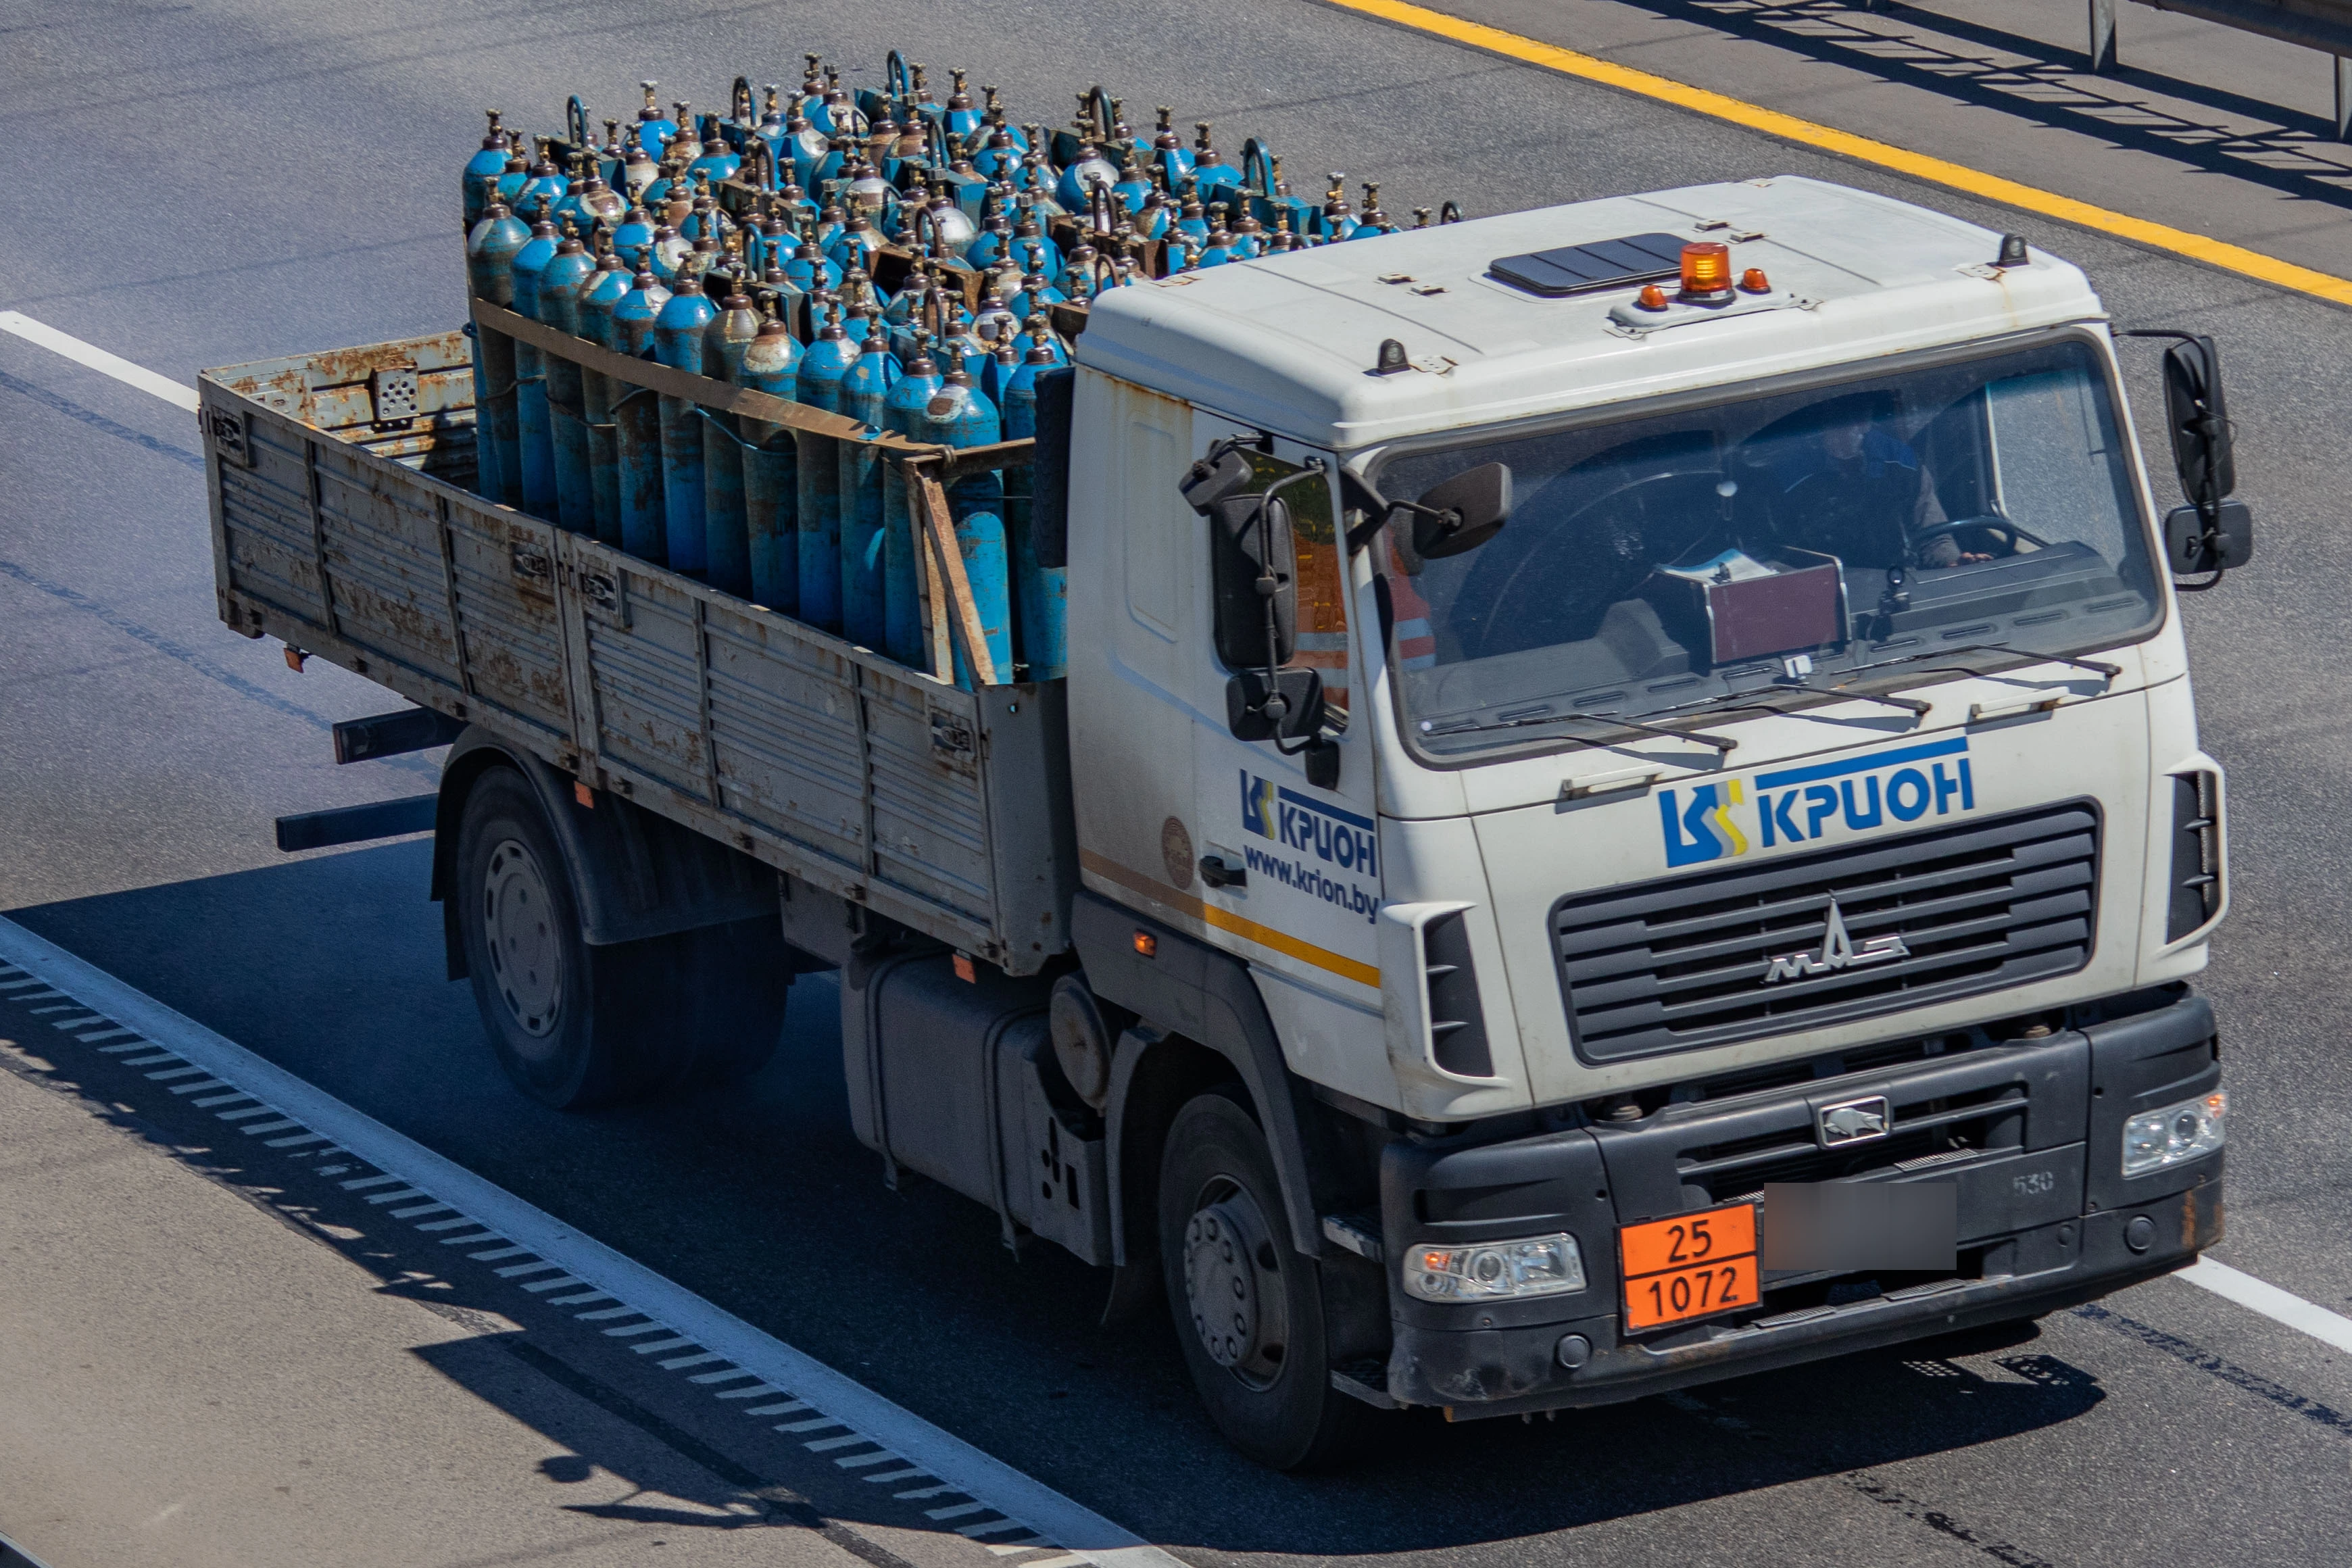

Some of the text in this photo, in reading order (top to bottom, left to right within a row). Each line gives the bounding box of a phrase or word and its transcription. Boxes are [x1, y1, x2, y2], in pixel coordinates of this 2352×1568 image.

[1243, 845, 1379, 925] www.krion.by
[1667, 1219, 1712, 1263] 25
[1648, 1266, 1739, 1317] 1072
